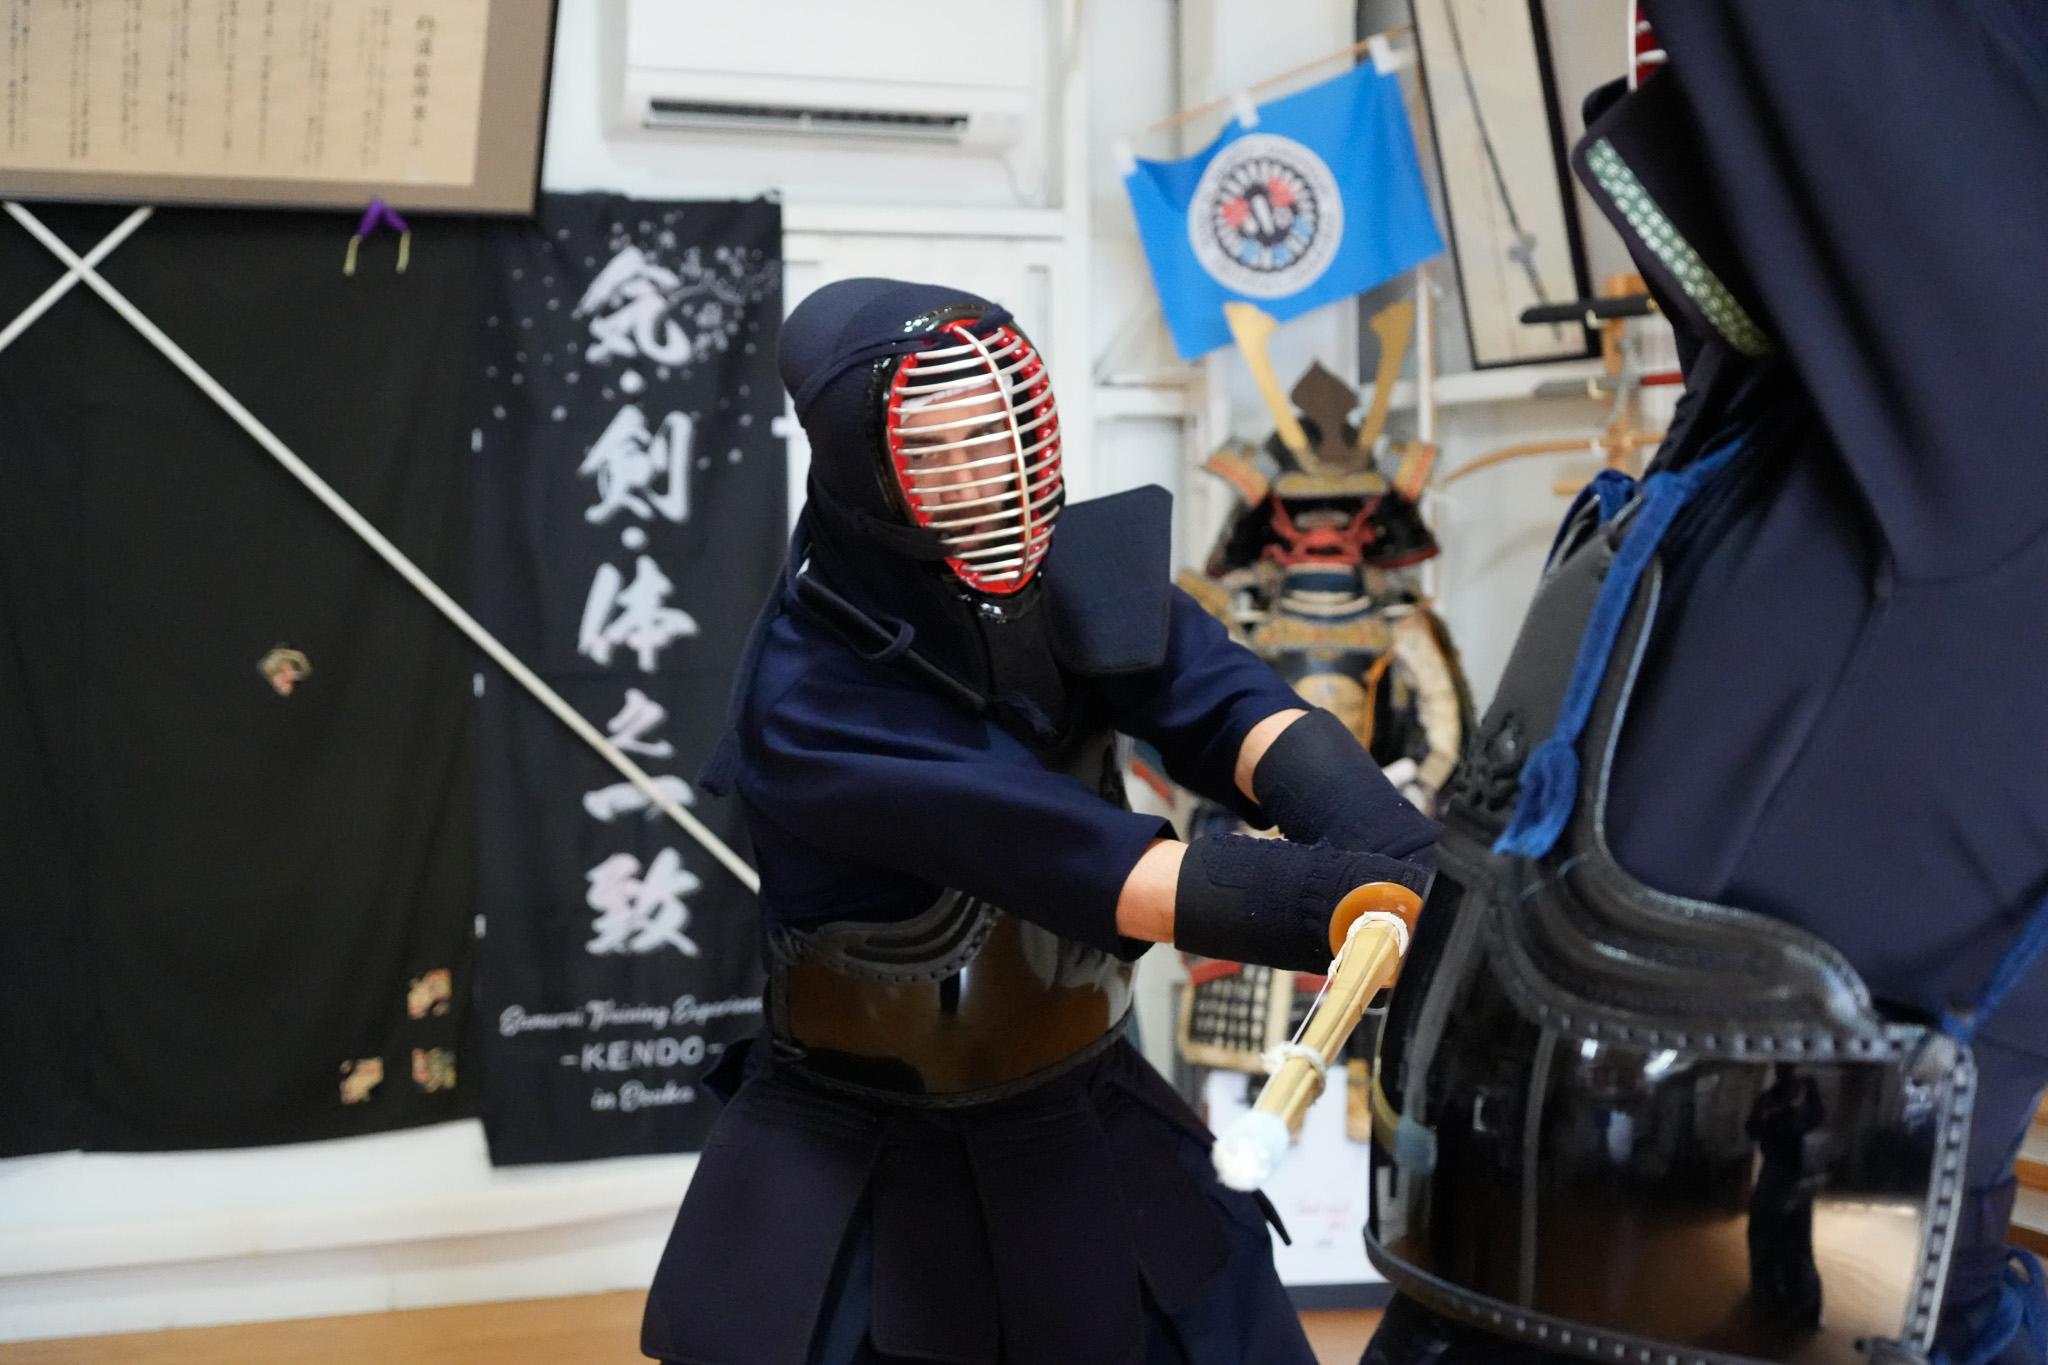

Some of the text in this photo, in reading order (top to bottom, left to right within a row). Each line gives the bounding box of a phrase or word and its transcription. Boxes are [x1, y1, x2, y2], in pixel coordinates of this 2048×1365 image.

[585, 999, 669, 1030] Training
[671, 994, 763, 1025] Experien
[591, 1079, 695, 1112] in Osaka
